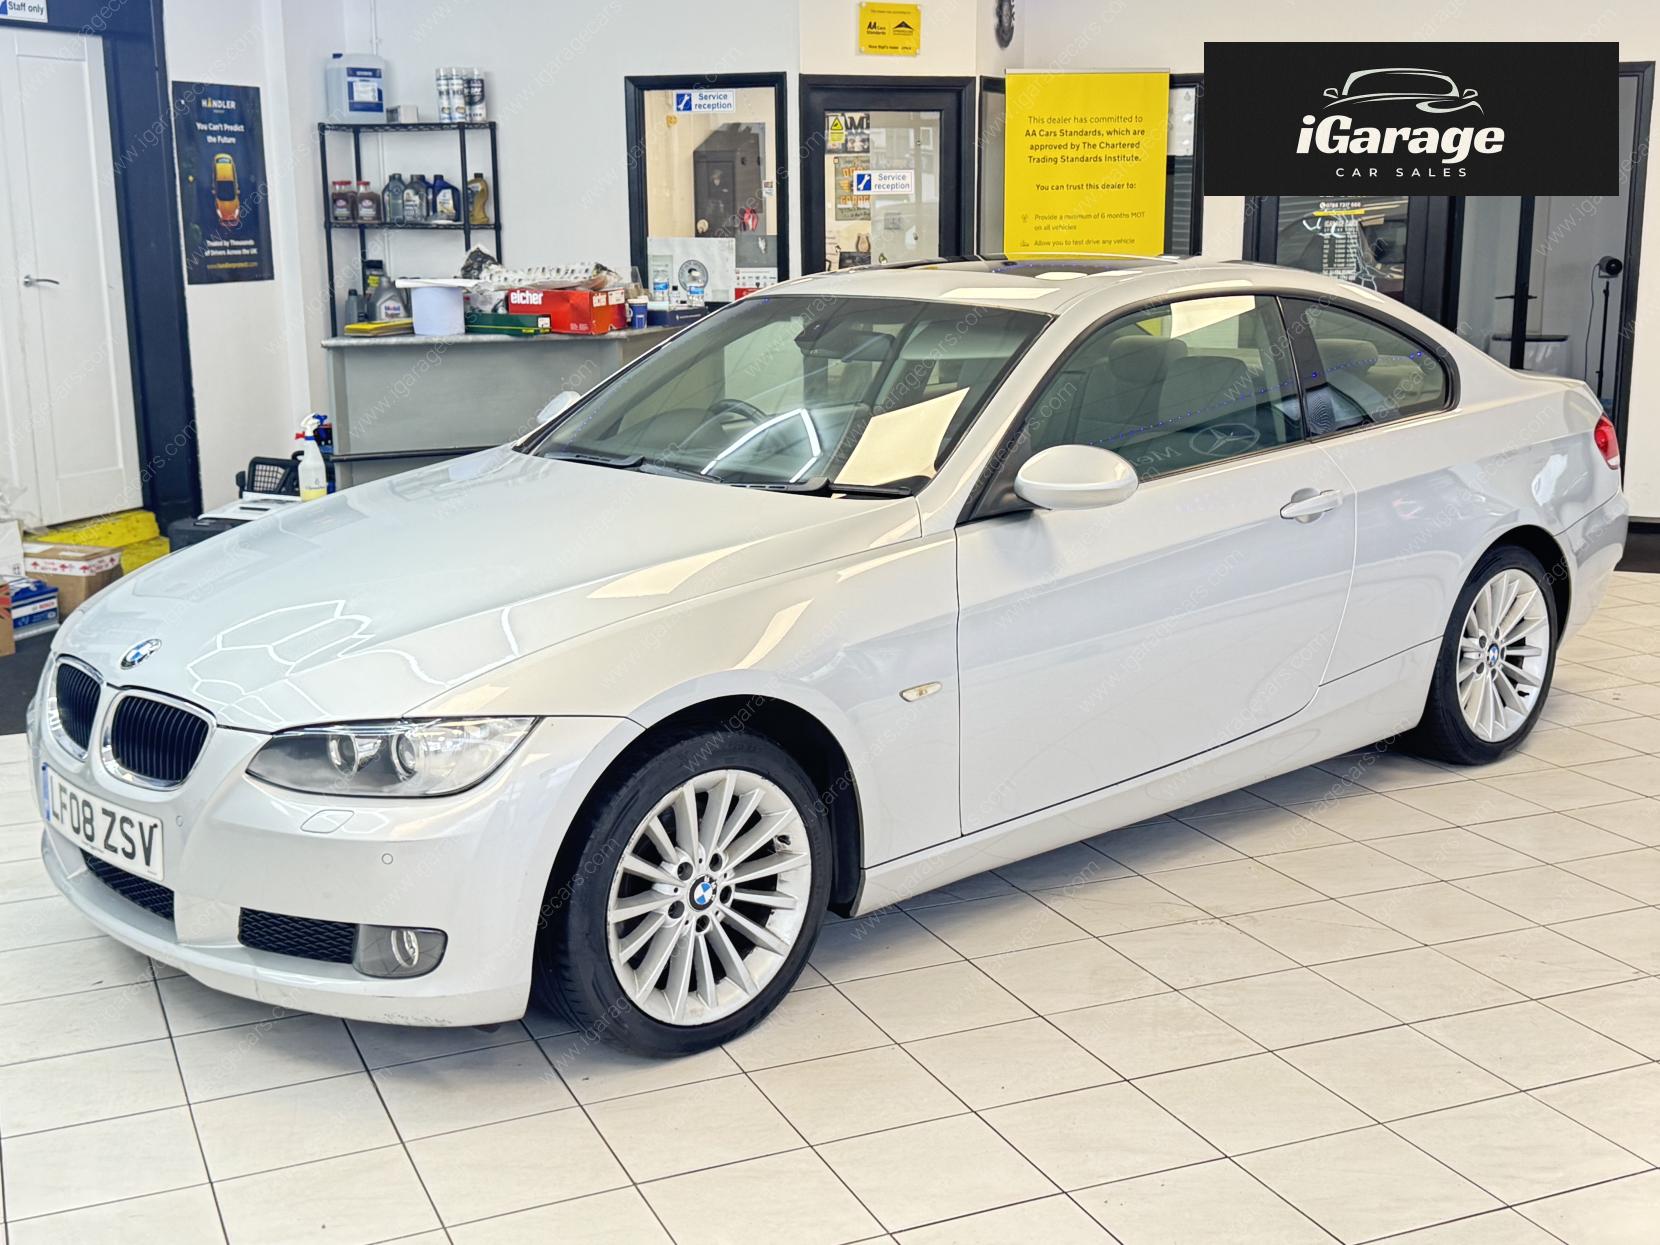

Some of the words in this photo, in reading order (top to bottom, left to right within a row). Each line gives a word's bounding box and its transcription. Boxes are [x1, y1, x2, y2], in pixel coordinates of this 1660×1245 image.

[8, 1, 26, 12] Staff
[28, 4, 44, 16] only
[698, 92, 728, 100] Service
[694, 102, 732, 110] reception
[1028, 116, 1045, 124] This
[1046, 116, 1072, 124] dealer
[1073, 116, 1088, 124] has
[1089, 115, 1133, 124] committed
[1135, 115, 1143, 123] to
[195, 122, 208, 131] You
[1025, 129, 1037, 137] AA
[1038, 129, 1058, 137] Cars
[1059, 129, 1105, 138] Standards,
[1106, 128, 1131, 136] which
[1029, 142, 1068, 151] approved
[1070, 142, 1080, 151] by
[1082, 142, 1097, 150] The
[1099, 141, 1141, 150] Chartered
[1028, 156, 1058, 165] Trading
[1060, 155, 1102, 163] Standards
[1104, 154, 1141, 162] Institute.
[878, 173, 907, 181] Service
[874, 182, 910, 191] reception
[510, 290, 543, 305] eicher
[50, 775, 95, 843] LF08
[101, 807, 154, 867] ZSV
